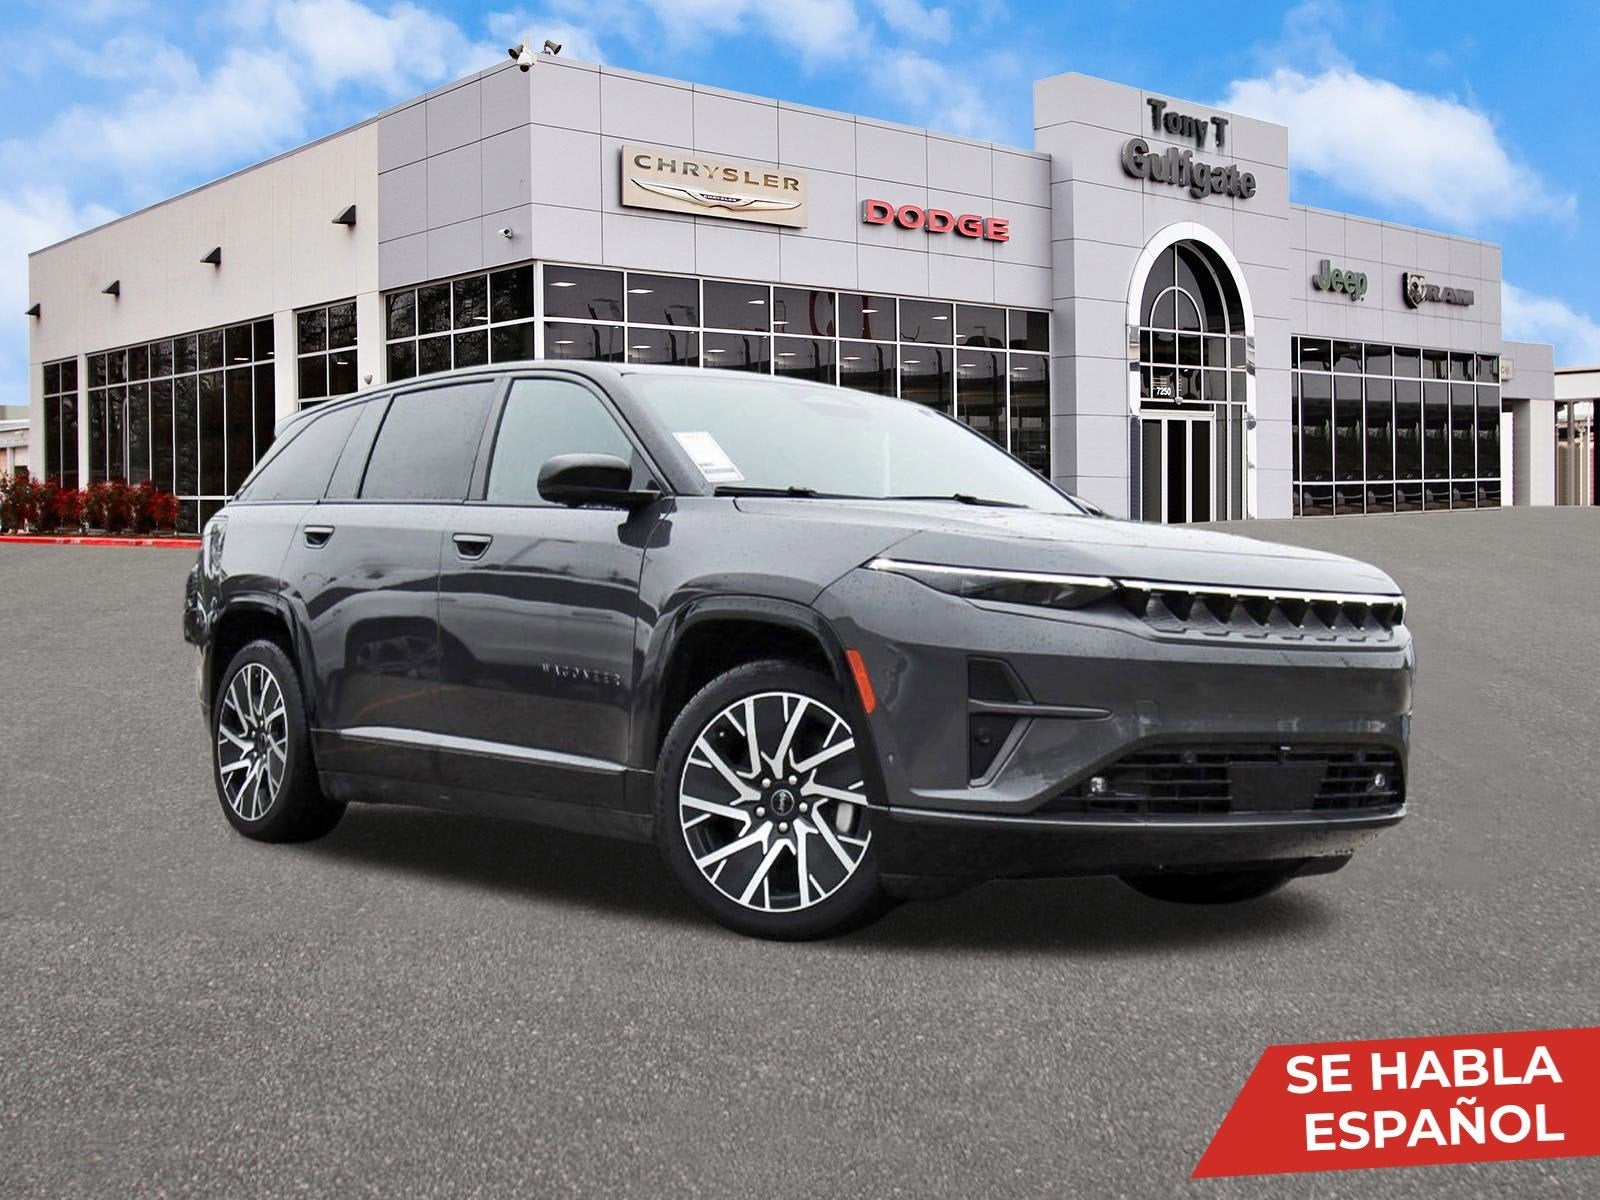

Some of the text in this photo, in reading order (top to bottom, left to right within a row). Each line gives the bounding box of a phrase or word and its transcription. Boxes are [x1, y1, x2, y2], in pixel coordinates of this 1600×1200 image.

[1147, 98, 1229, 148] Tony T
[633, 154, 800, 192] CHRYSLER
[1121, 137, 1257, 199] Gulfgate
[862, 198, 1010, 242] DODGE
[1312, 259, 1368, 302] Jeep
[1425, 284, 1475, 306] RAM
